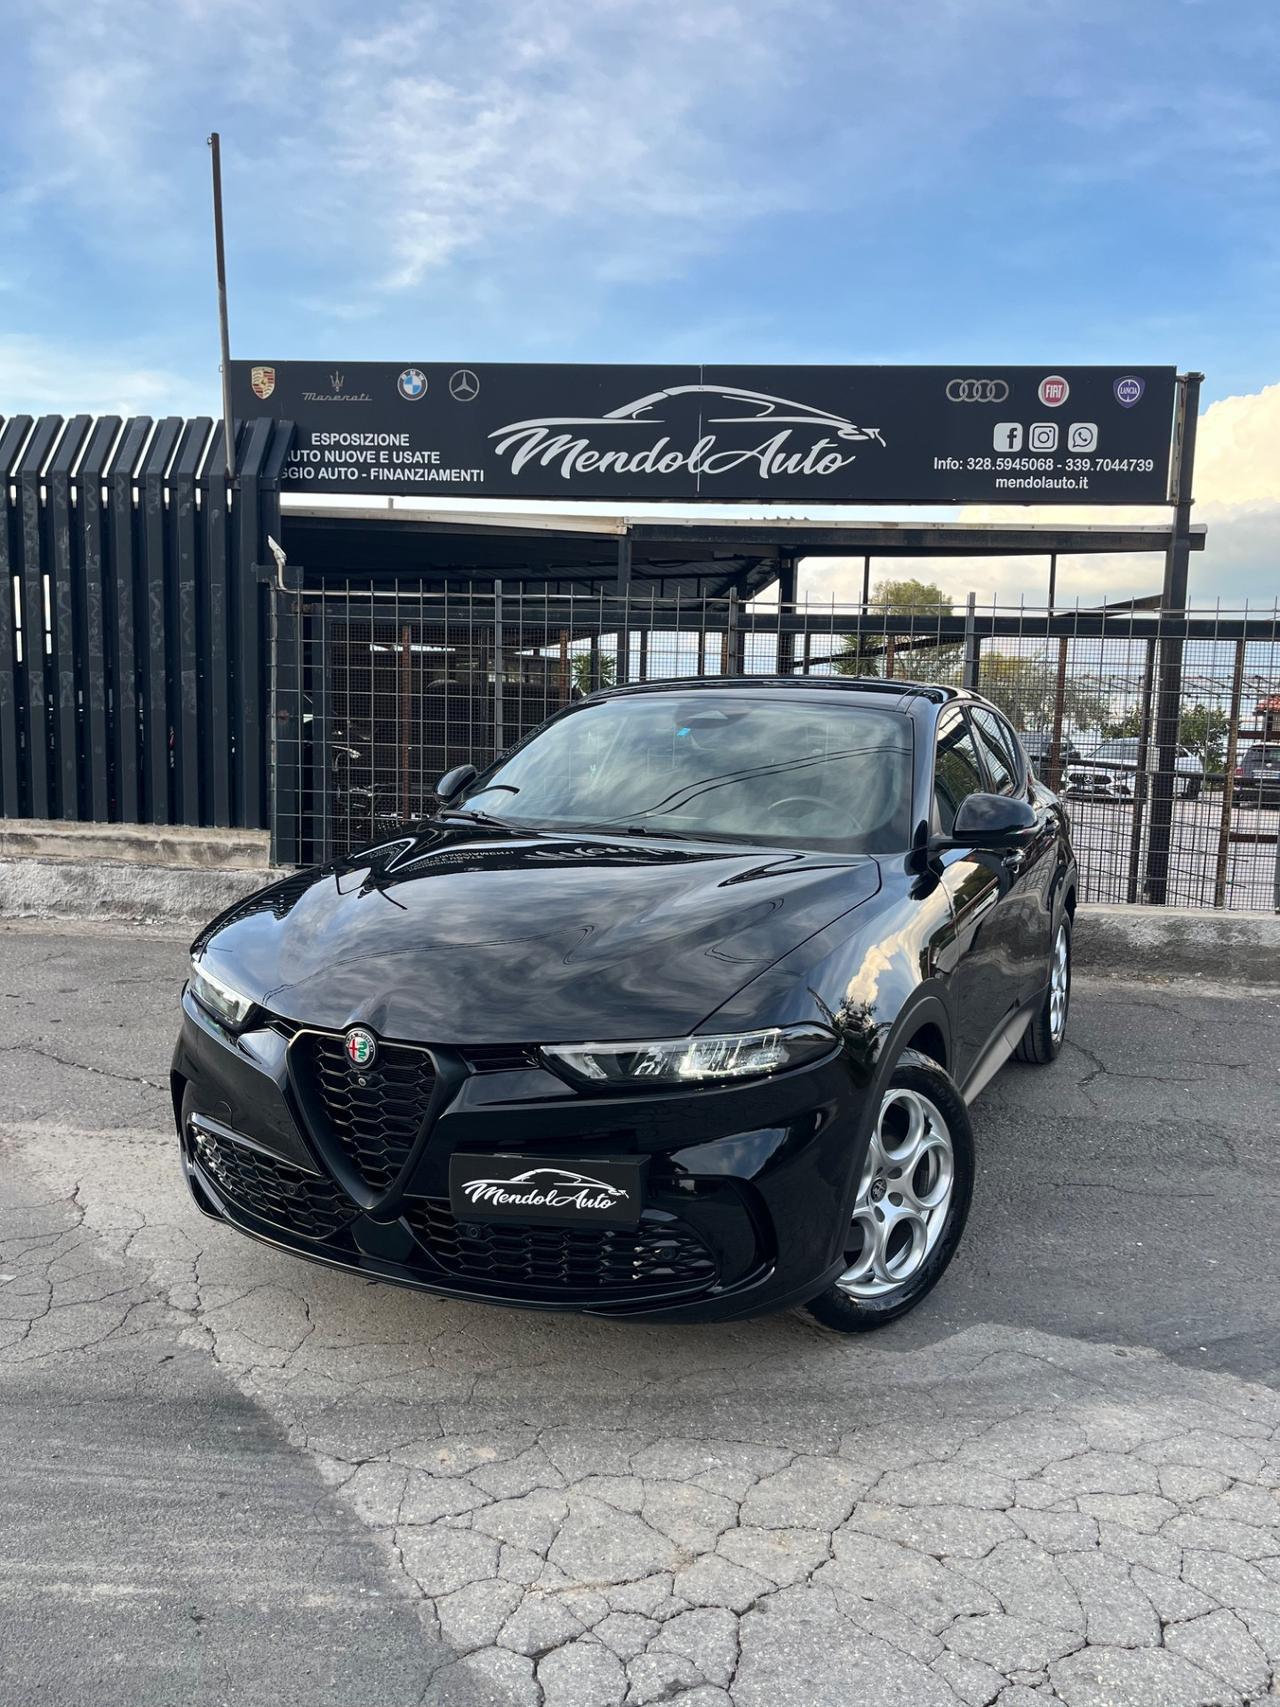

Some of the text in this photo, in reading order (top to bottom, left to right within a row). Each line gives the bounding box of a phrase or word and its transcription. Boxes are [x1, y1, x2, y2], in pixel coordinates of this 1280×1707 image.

[1045, 384, 1063, 398] FIAT
[1119, 386, 1138, 395] LANCIA
[311, 433, 410, 446] ESPOSIZIONE
[287, 450, 441, 463] UTO NUOVE E USATE
[933, 457, 964, 469] Info:
[966, 458, 1054, 470] 328.5945068
[1065, 459, 1154, 471] 339.7044739
[318, 467, 359, 479] AUTO
[370, 468, 485, 482] FINANZIAMENTI
[995, 476, 1089, 489] mendolauto.it
